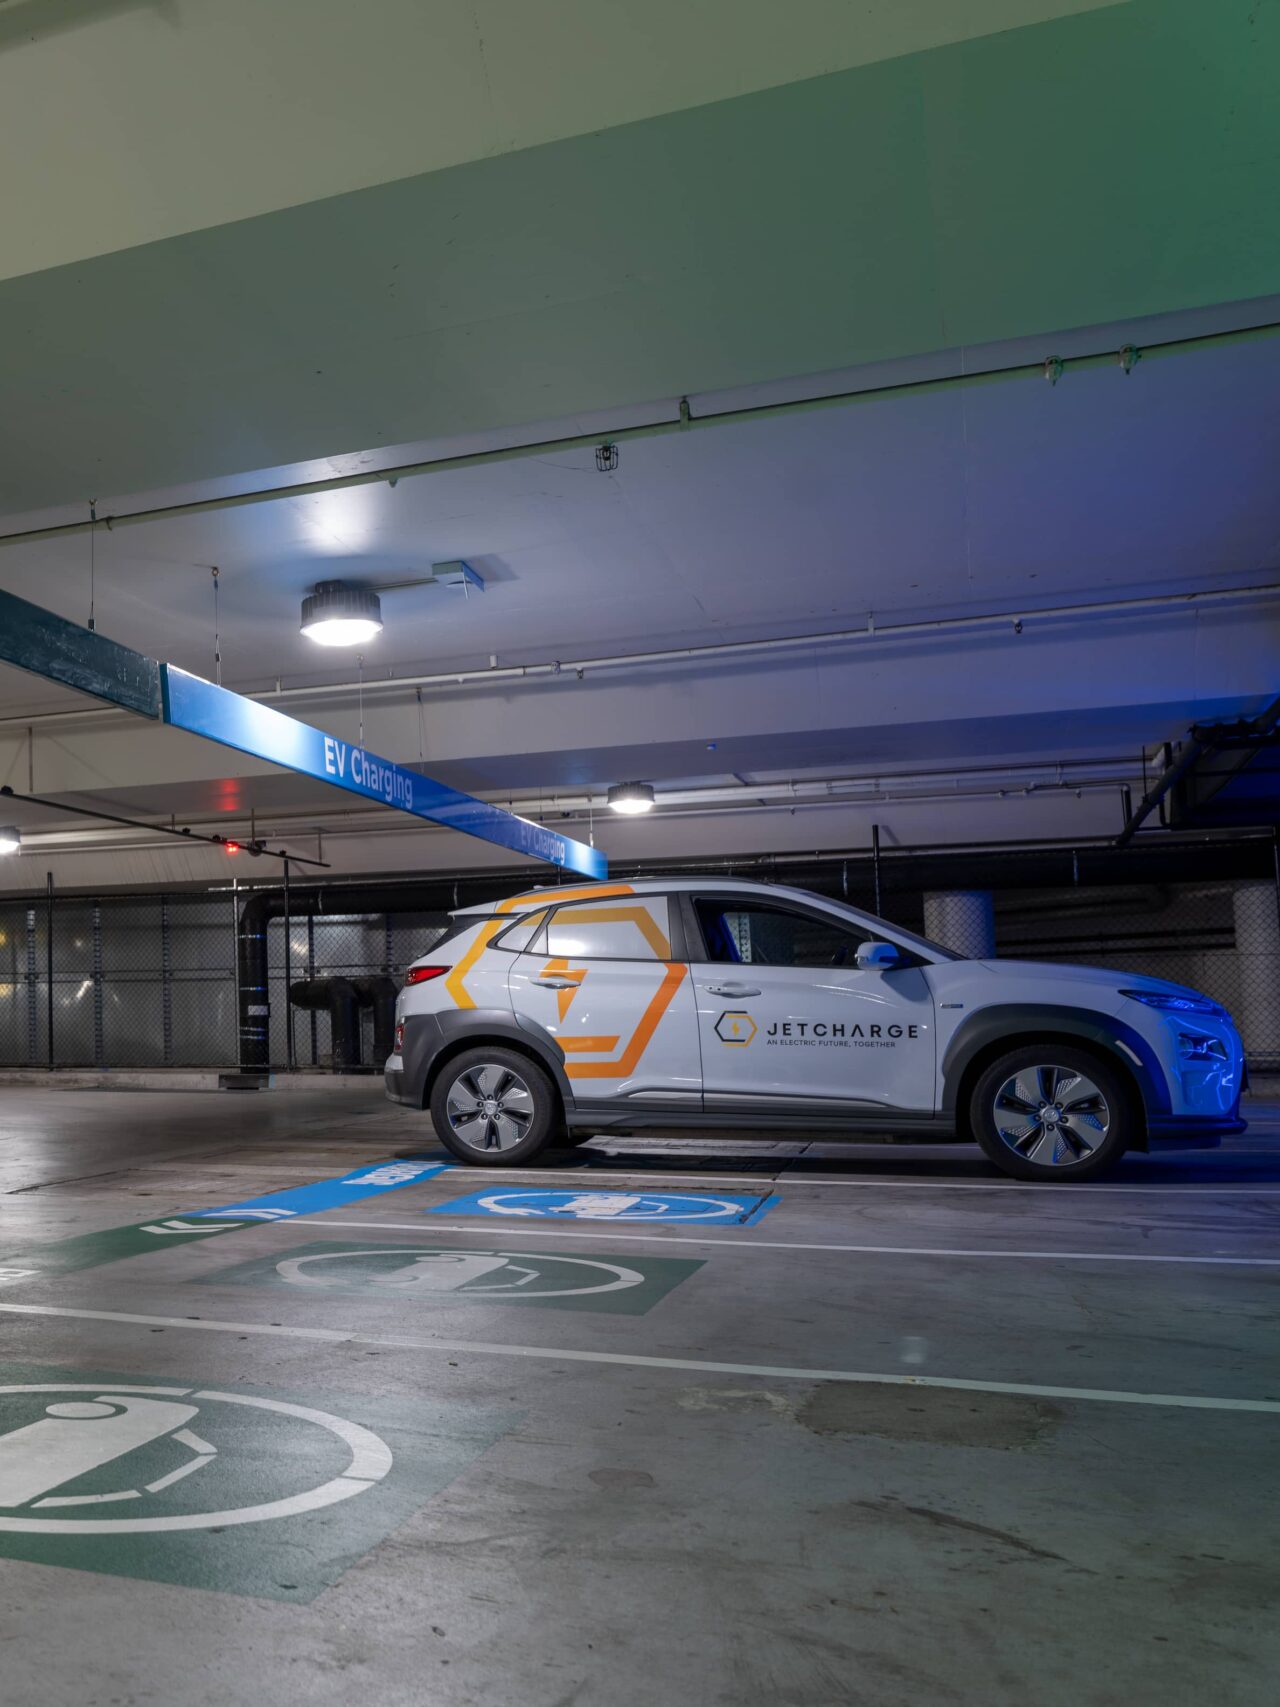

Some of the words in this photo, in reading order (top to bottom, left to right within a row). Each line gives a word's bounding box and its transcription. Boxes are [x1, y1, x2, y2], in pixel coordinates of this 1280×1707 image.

[324, 736, 346, 778] EV
[351, 748, 413, 810] Charging
[521, 823, 531, 847] EV
[533, 829, 565, 865] Charging
[767, 1022, 918, 1039] JETCHARGE
[780, 1039, 817, 1047] ELECTRIC
[818, 1040, 852, 1048] FUTURE,
[854, 1040, 896, 1048] TOGETHER
